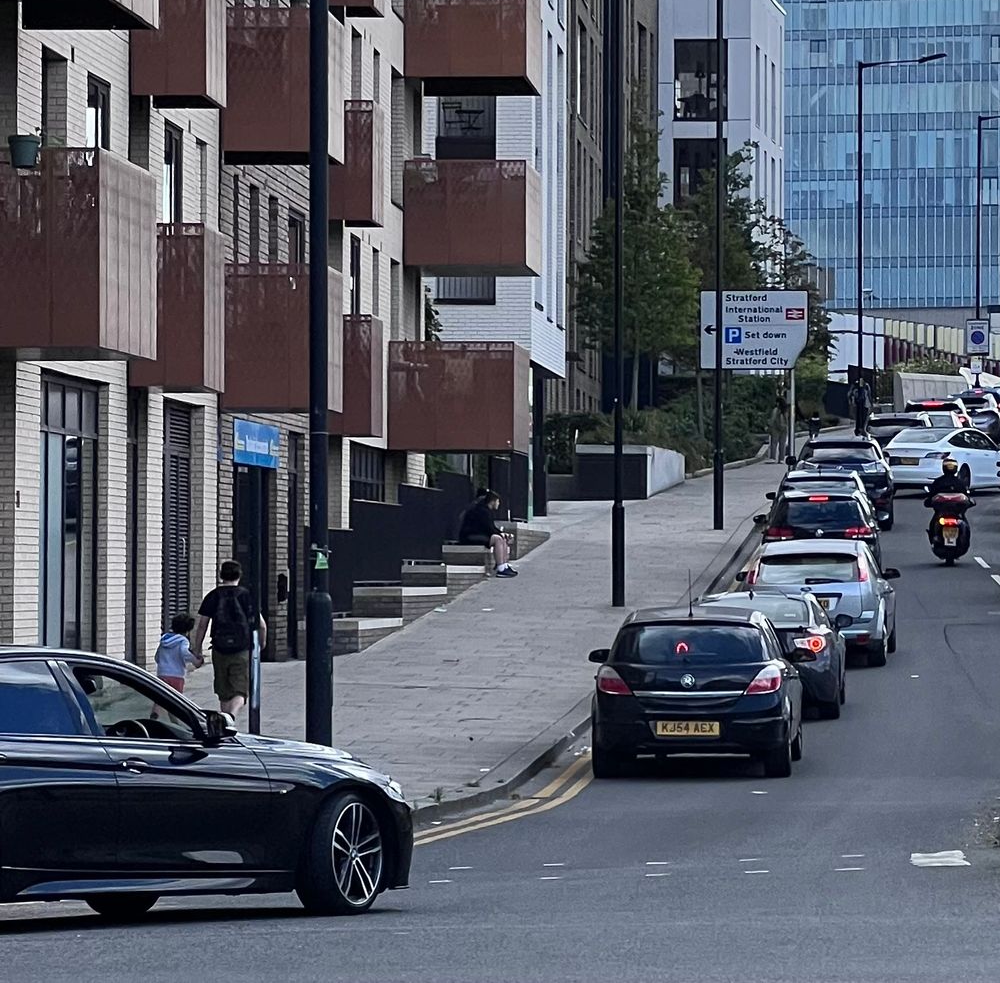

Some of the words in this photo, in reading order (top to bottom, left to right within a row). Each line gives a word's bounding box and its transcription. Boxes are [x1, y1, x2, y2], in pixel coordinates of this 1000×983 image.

[725, 294, 767, 302] Stratford
[725, 306, 783, 314] International
[738, 315, 771, 323] Station
[744, 331, 760, 339] Set
[763, 331, 787, 339] down
[736, 348, 778, 356] Westfield
[725, 357, 767, 365] Stratford
[770, 357, 789, 366] City
[661, 722, 690, 734] KJ54
[693, 723, 715, 733] AEX
